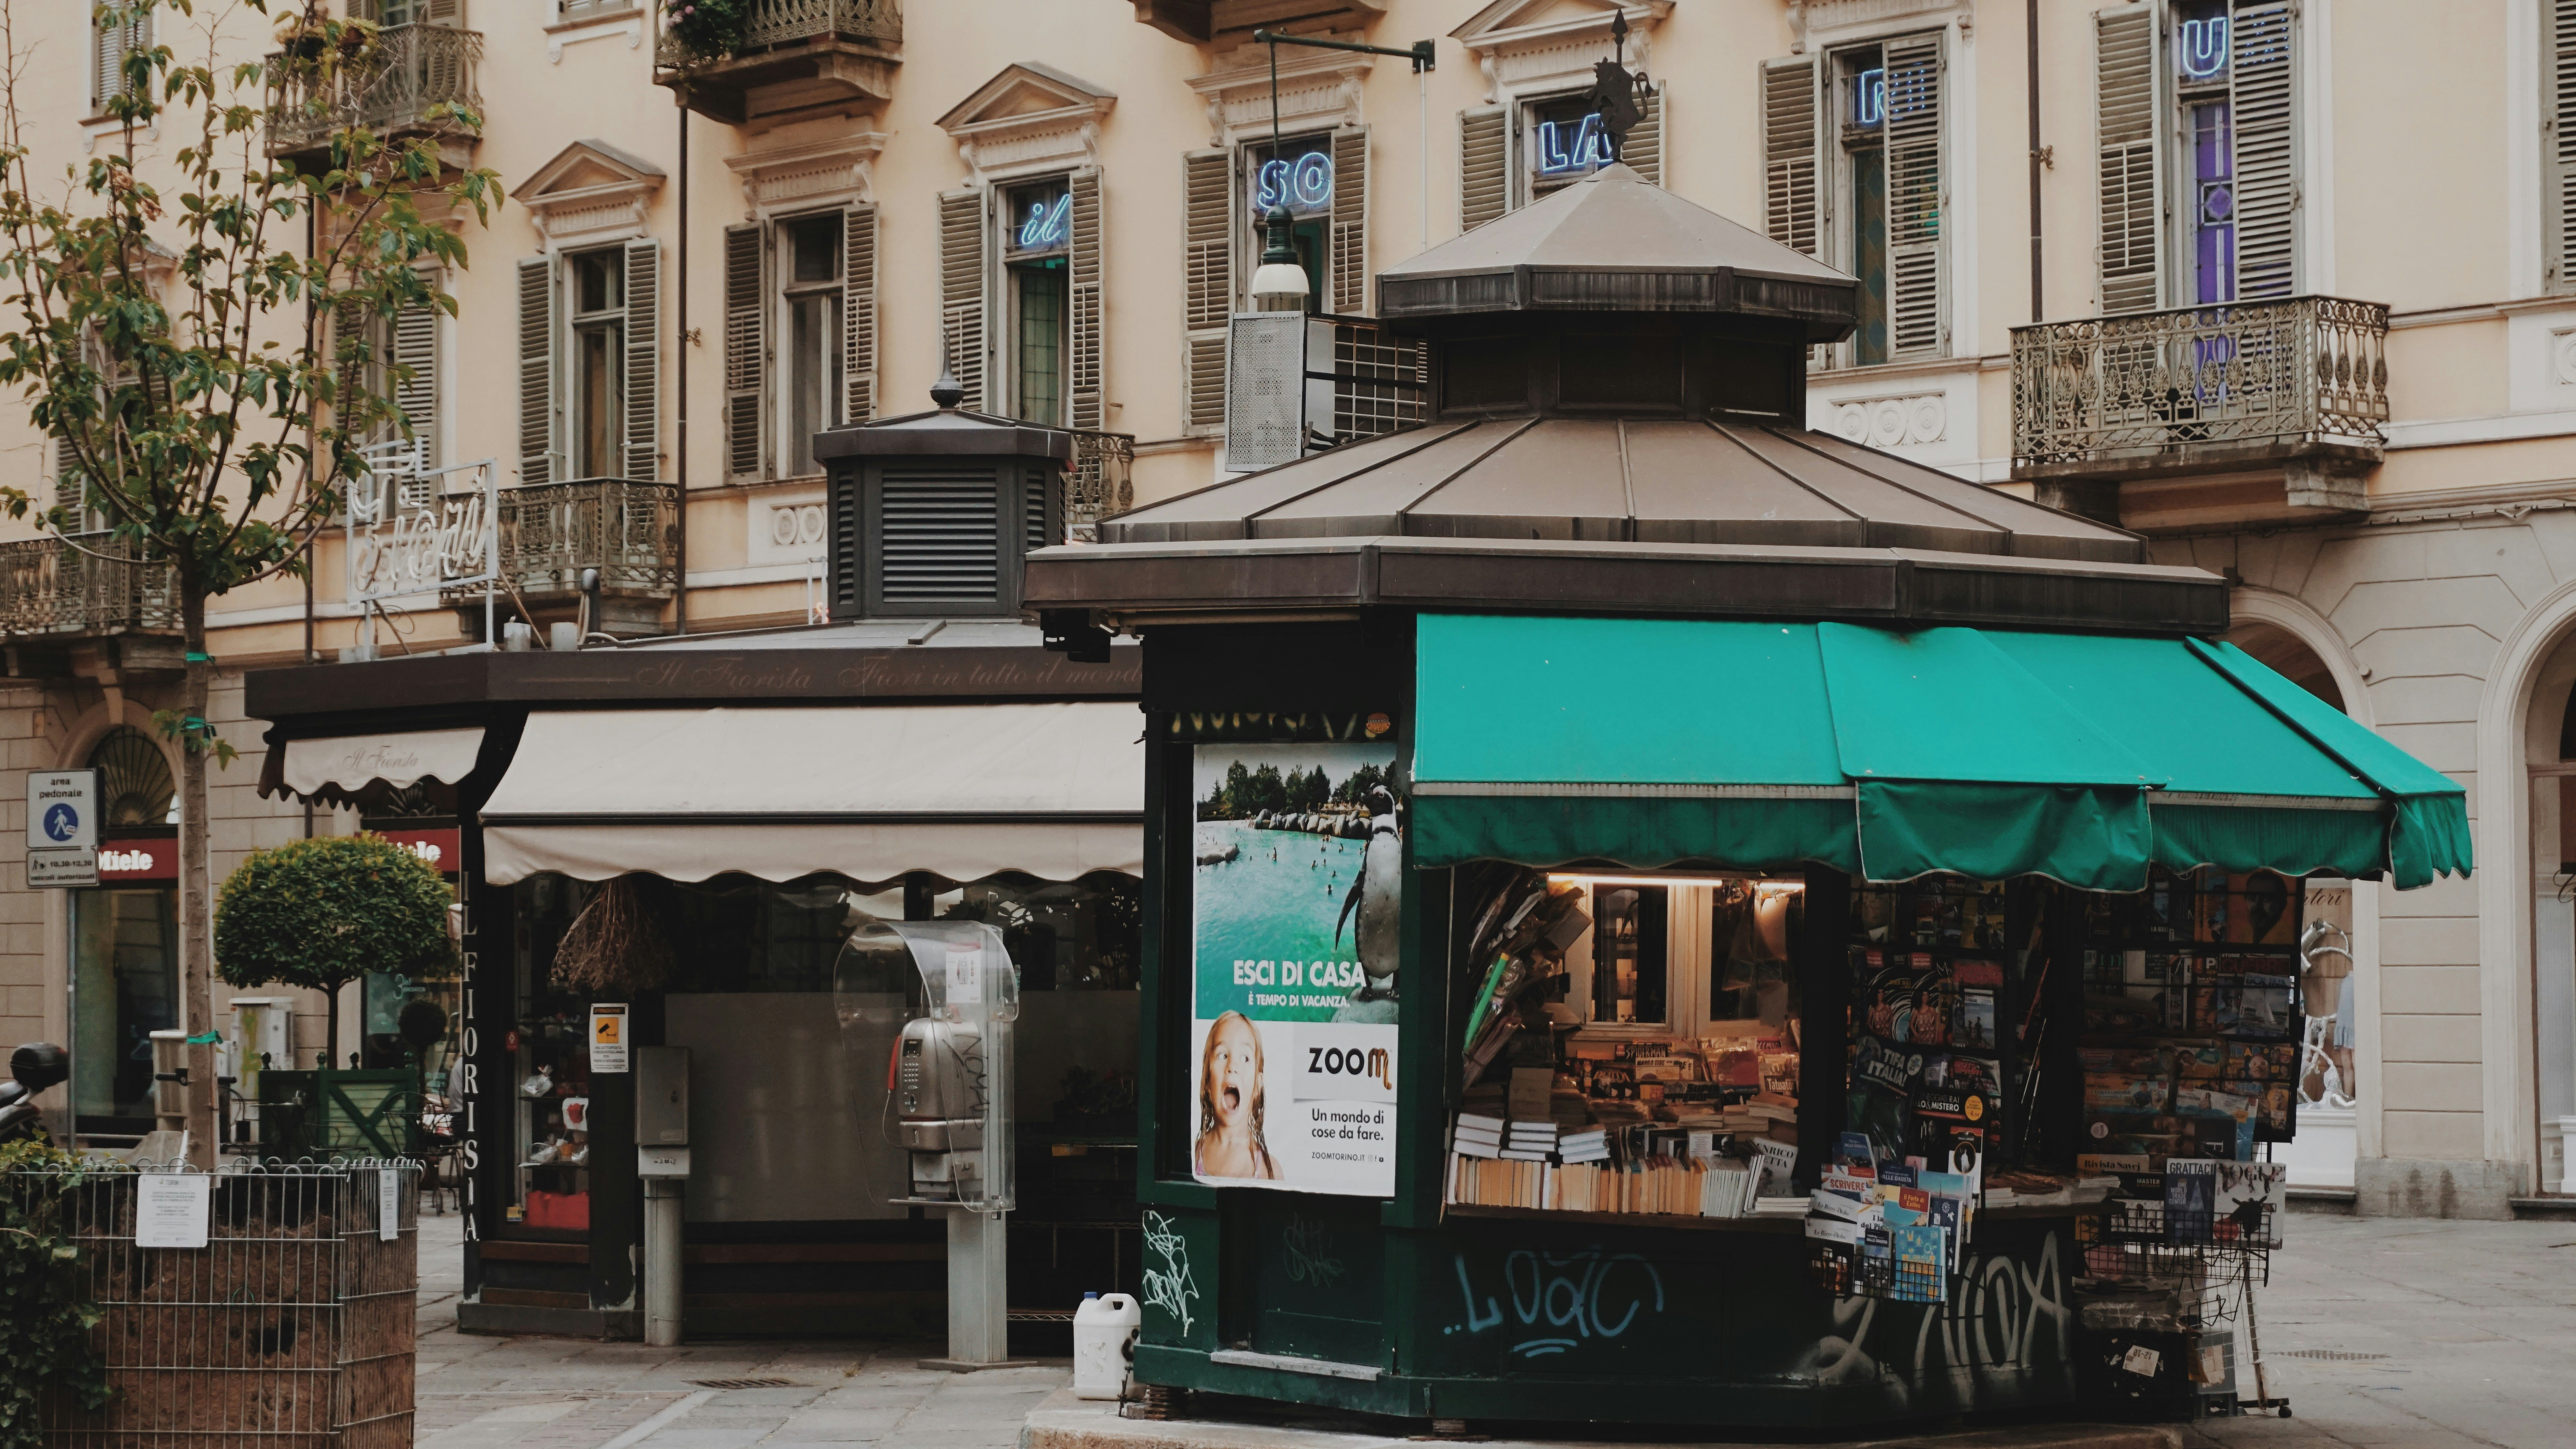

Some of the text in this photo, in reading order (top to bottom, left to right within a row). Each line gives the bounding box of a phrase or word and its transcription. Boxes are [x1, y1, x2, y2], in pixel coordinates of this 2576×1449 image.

[1021, 194, 1070, 246] il
[1540, 113, 1613, 171] LA
[636, 659, 686, 687] Il
[690, 656, 814, 688] Fiorista
[932, 666, 958, 686] in
[969, 662, 1028, 685] tutto
[1036, 656, 1062, 684] il
[343, 745, 419, 769] Il Fiorista
[50, 778, 70, 786] area
[39, 788, 82, 799] pedonale
[98, 849, 153, 871] Miele
[1233, 959, 1367, 987] ESCI DI CASA
[1248, 990, 1350, 1007] È TEMPO DI VACANZA.
[1883, 1048, 1906, 1070] TIFA
[1868, 1060, 1908, 1088] ITALIA!
[1932, 1101, 1959, 1112] MISTERO
[1949, 1095, 1959, 1103] RAI
[1312, 1108, 1384, 1125] Un mondo di
[1311, 1125, 1384, 1141] cose da fare.
[1311, 1152, 1365, 1162] ZOOMTORINO.IT
[1830, 1178, 1865, 1192] SCRIVERE
